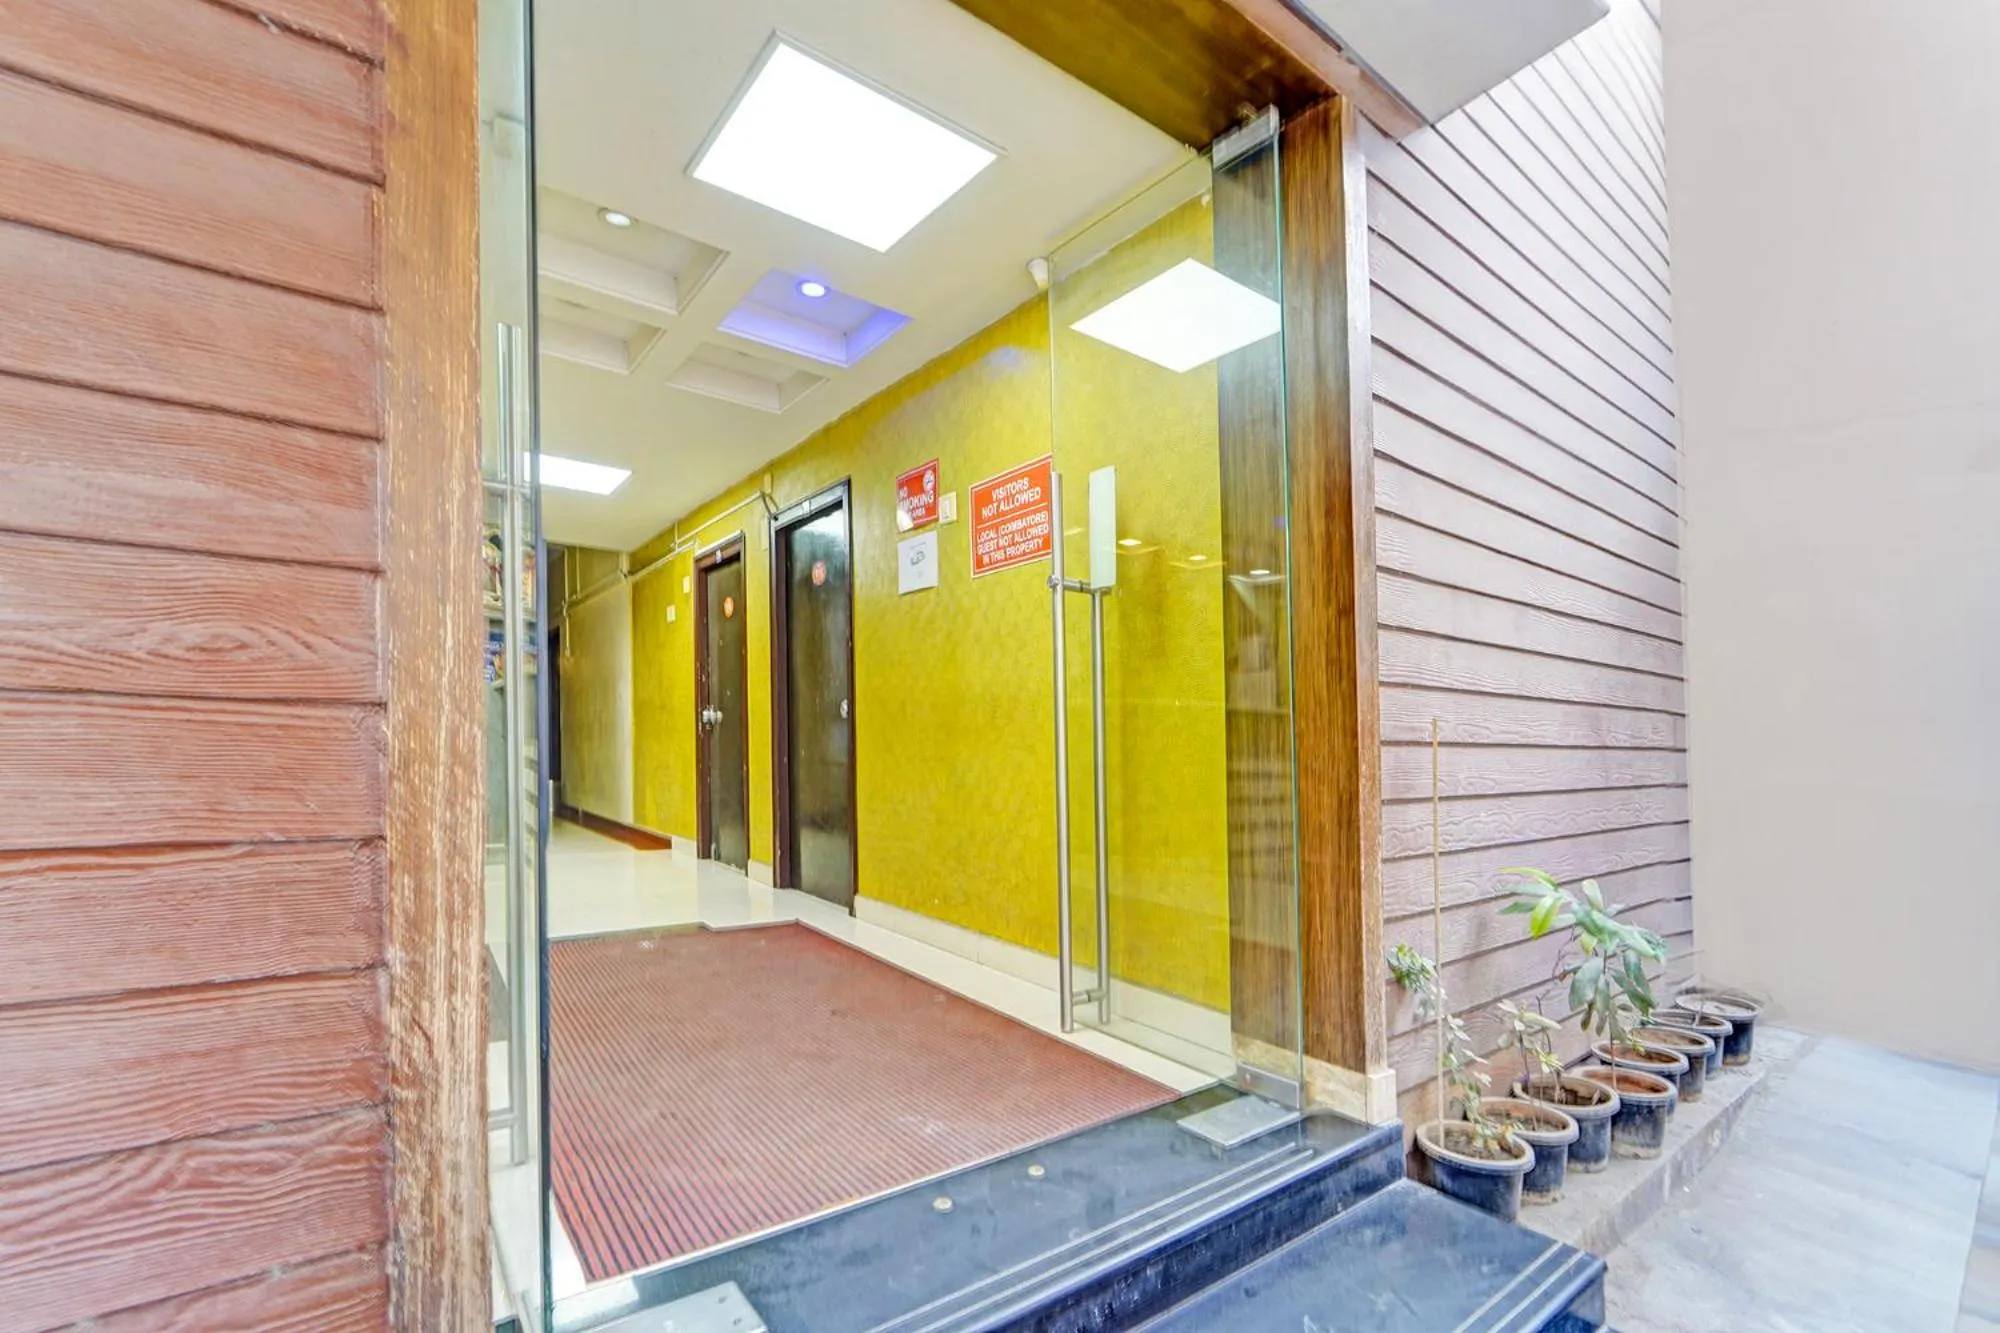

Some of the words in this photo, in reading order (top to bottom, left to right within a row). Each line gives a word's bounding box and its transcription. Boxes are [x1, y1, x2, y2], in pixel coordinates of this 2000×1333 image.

[982, 503, 997, 519] NOT
[999, 487, 1041, 512] ALLOWED
[992, 477, 1030, 502] VISITORS
[977, 528, 998, 543] LOCAL
[977, 540, 998, 555] GUEST
[999, 534, 1013, 546] NOT
[1014, 523, 1049, 543] ALLOWED
[982, 555, 990, 567] IN
[990, 550, 1005, 564] THIS
[1006, 538, 1043, 558] PROPERTY
